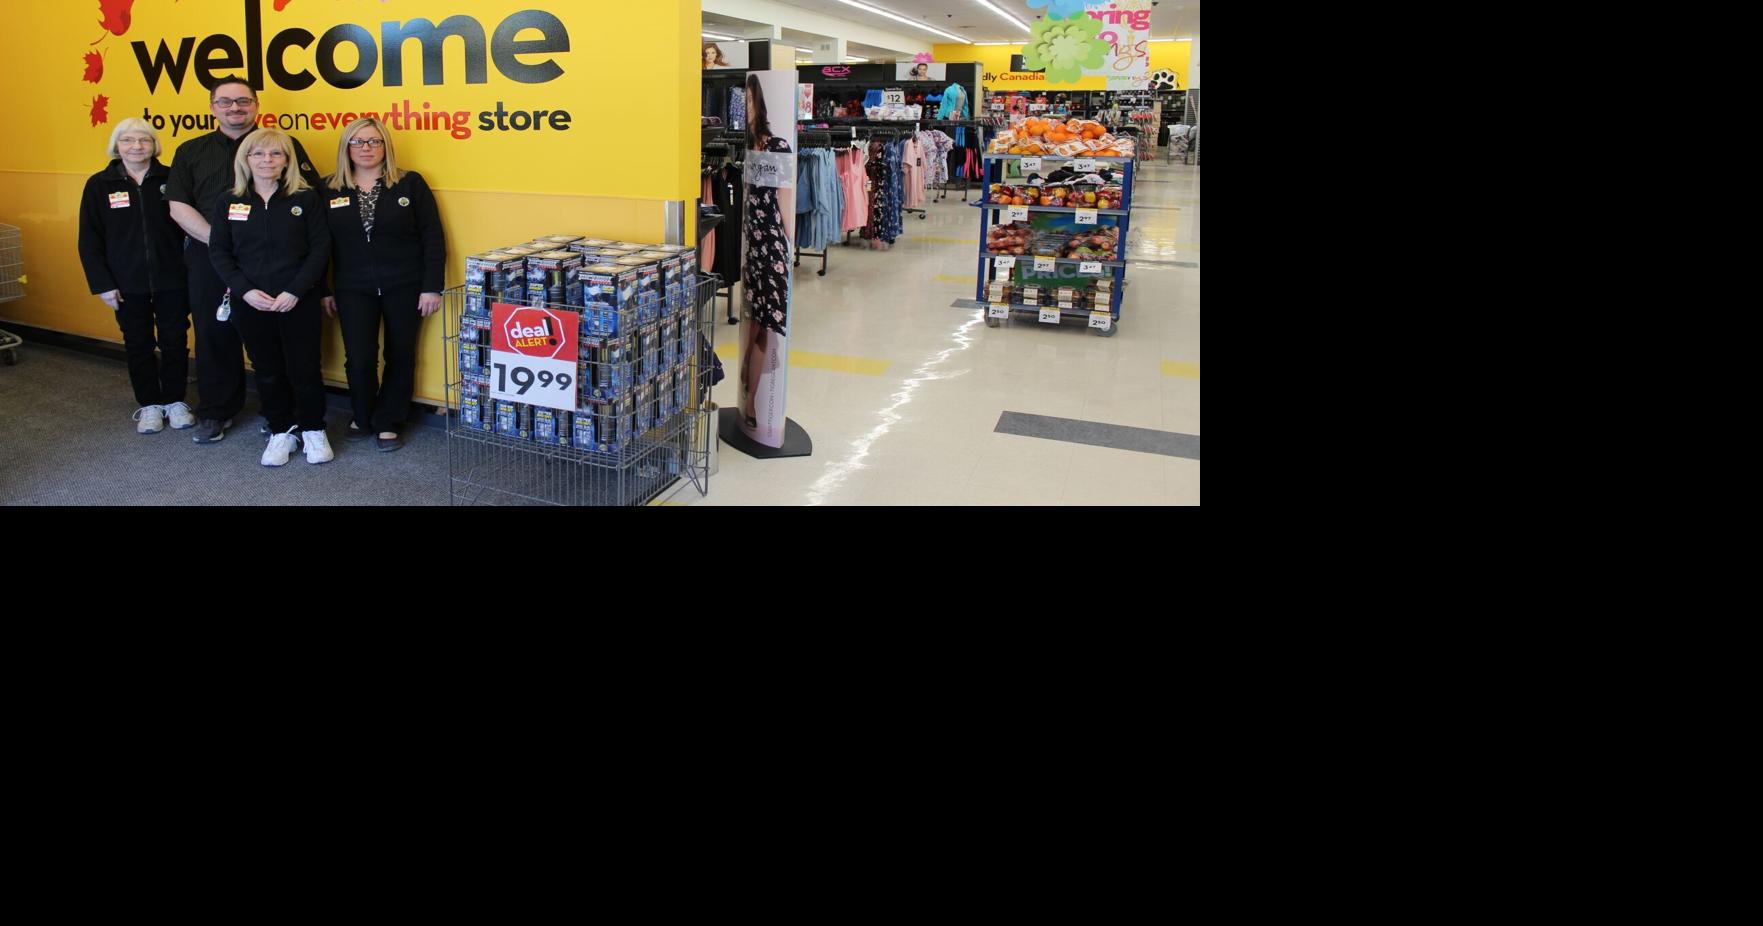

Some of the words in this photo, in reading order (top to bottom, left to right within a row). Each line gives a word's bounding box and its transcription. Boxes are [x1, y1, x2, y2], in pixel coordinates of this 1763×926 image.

[131, 0, 570, 95] welcome
[999, 71, 1046, 81] Canadia
[143, 107, 165, 130] to
[171, 112, 216, 137] your
[478, 101, 572, 131] store
[515, 337, 548, 348] ALERT
